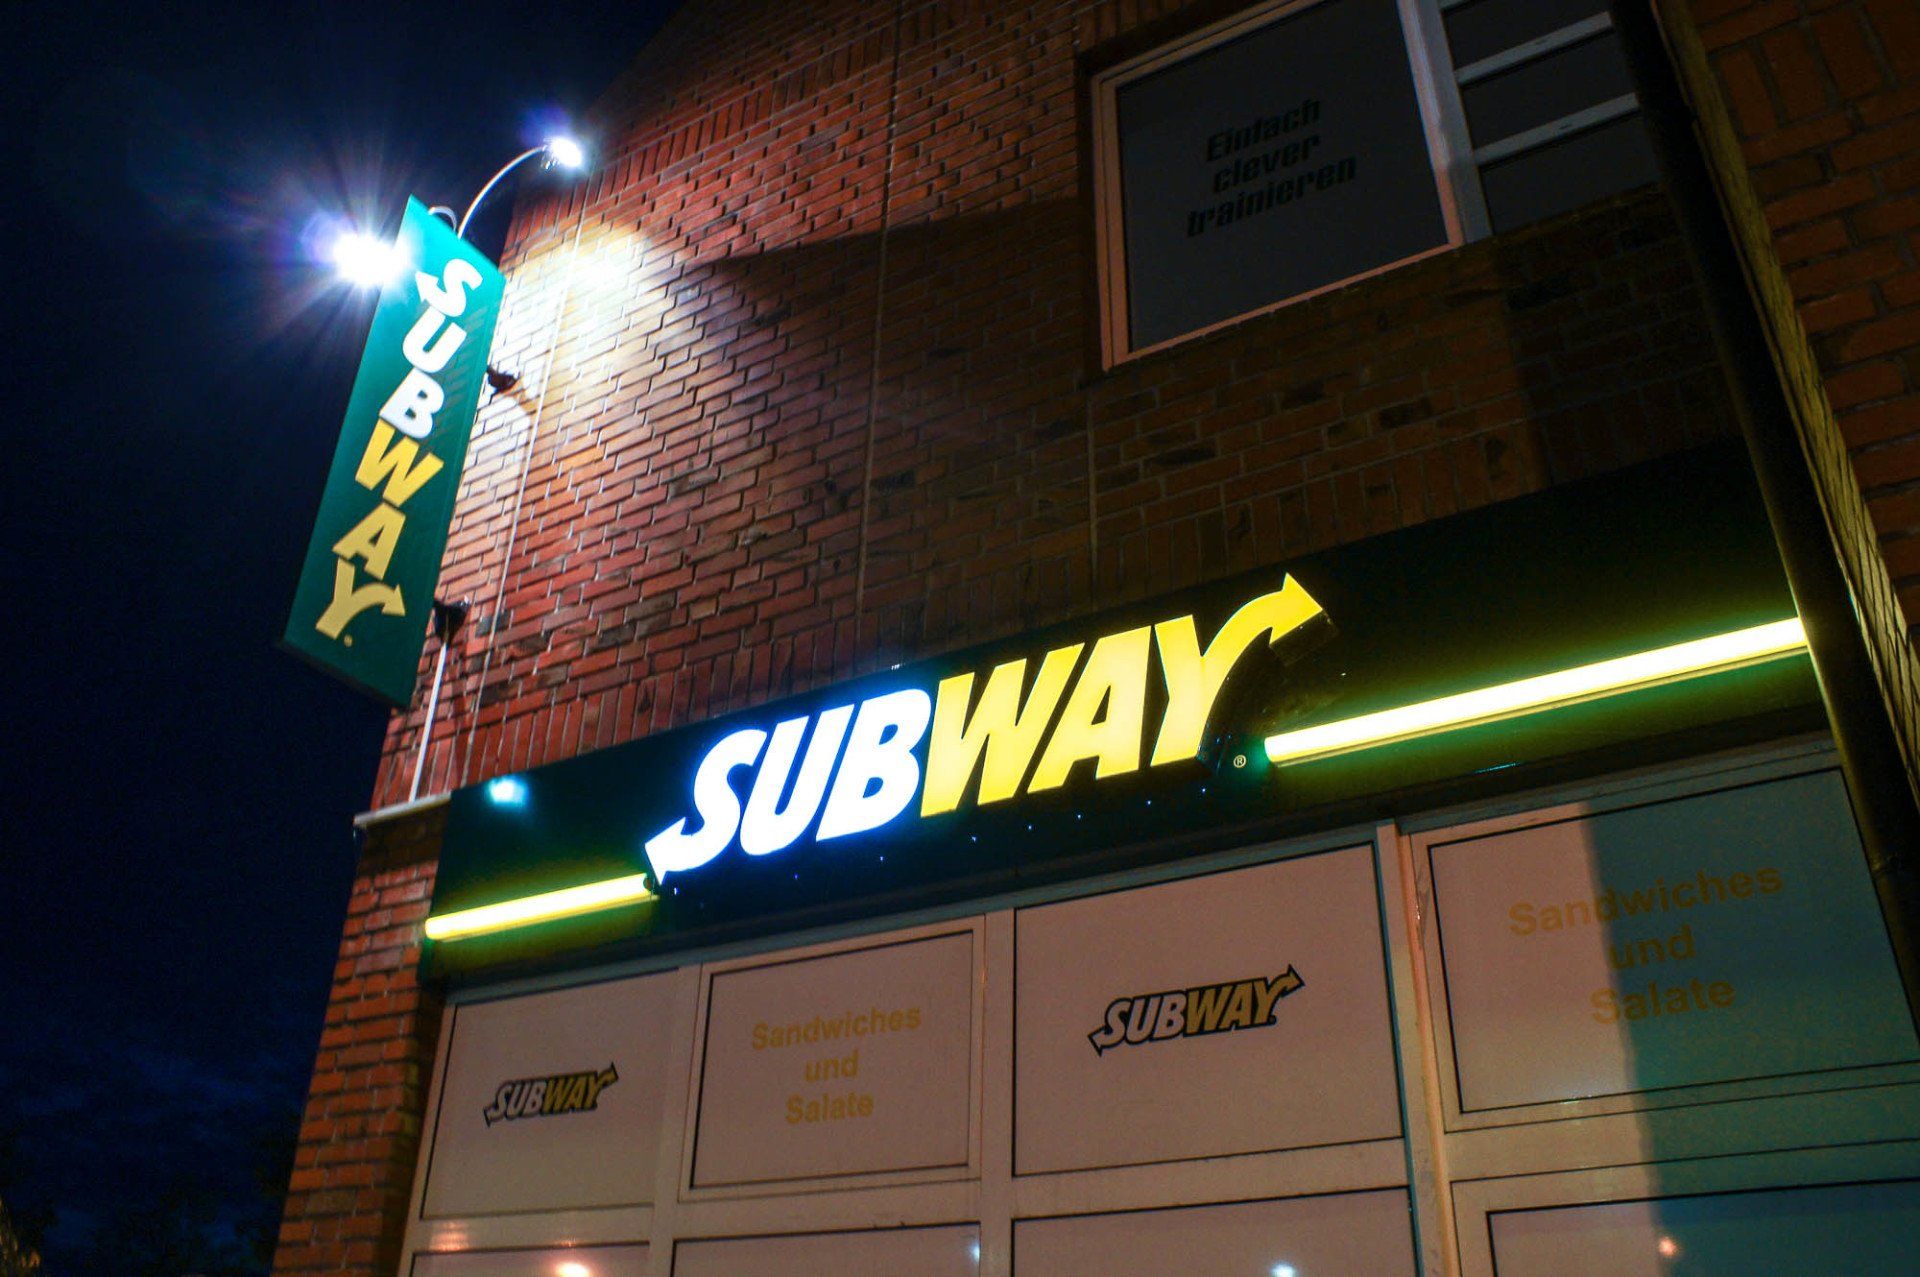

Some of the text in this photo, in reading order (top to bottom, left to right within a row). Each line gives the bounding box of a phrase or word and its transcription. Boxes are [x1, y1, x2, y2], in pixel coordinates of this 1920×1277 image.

[1207, 98, 1321, 163] Einfach
[1213, 133, 1321, 193] clever
[1186, 156, 1358, 237] trainieren
[316, 259, 482, 640] SUBWAY
[645, 573, 1323, 885] SUBWAY
[1508, 868, 1783, 936] Sandwiches
[1610, 926, 1696, 970] und
[753, 1006, 921, 1050] Sandwiches
[1088, 965, 1305, 1056] SUBWAY
[1591, 980, 1735, 1024] Salate
[484, 1063, 619, 1127] SUBWAY
[806, 1053, 858, 1082] und
[787, 1092, 875, 1125] Salate
